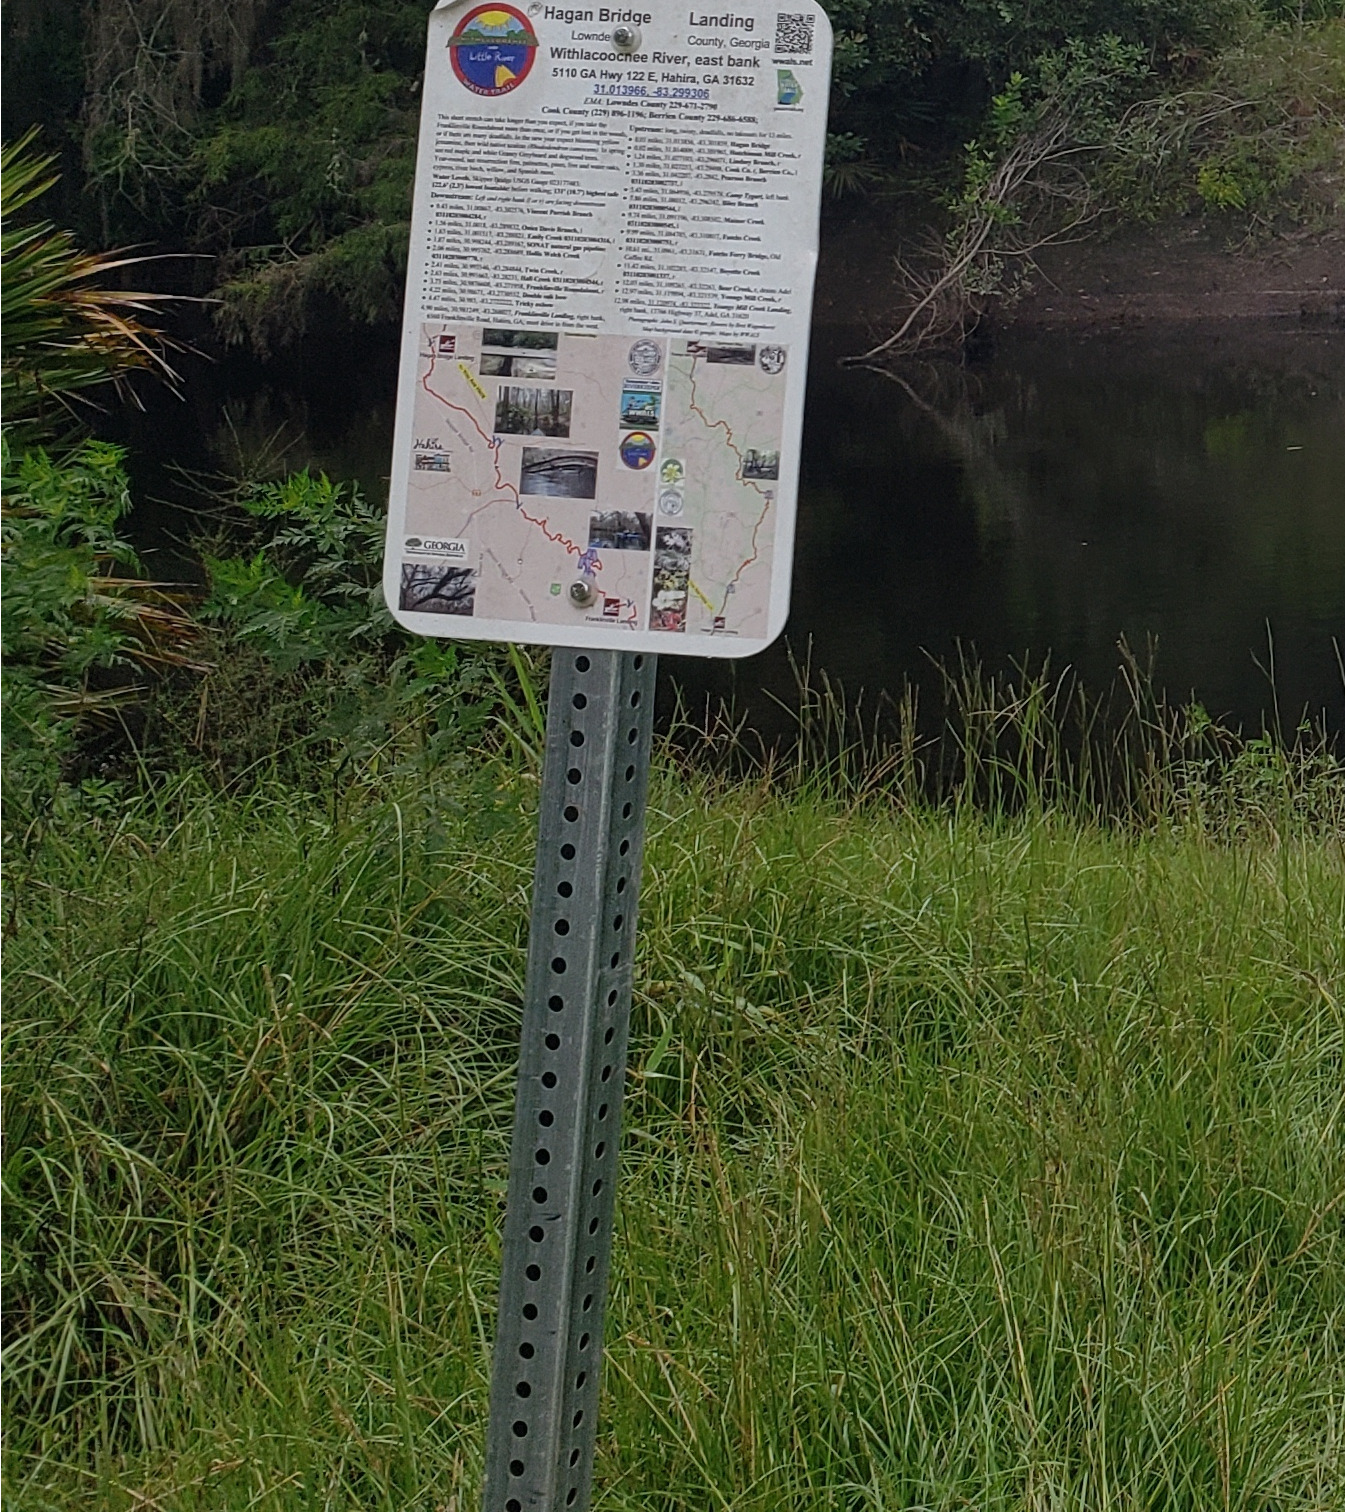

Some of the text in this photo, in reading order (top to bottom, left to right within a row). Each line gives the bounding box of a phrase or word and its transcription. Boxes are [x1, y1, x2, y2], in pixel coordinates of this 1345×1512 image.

[545, 6, 754, 31] Hagan Bridge Landing
[571, 31, 770, 49] Lownde County, Georgia
[469, 52, 515, 62] Little River
[652, 49, 690, 67] River,
[695, 55, 724, 66] east
[728, 52, 760, 68] bank
[772, 58, 813, 66] wwals.net
[552, 68, 754, 86] 5110 GA Hwy 122 E, Hahira, GA 31632
[593, 84, 649, 97] 31.013966,
[606, 98, 638, 107] Lowndes
[640, 99, 667, 110] County
[542, 106, 560, 115] Cook
[563, 108, 588, 118] County
[591, 108, 609, 118] (229)
[649, 111, 676, 120] Berrien
[679, 112, 704, 122] County
[424, 541, 465, 552] GEORGIA
